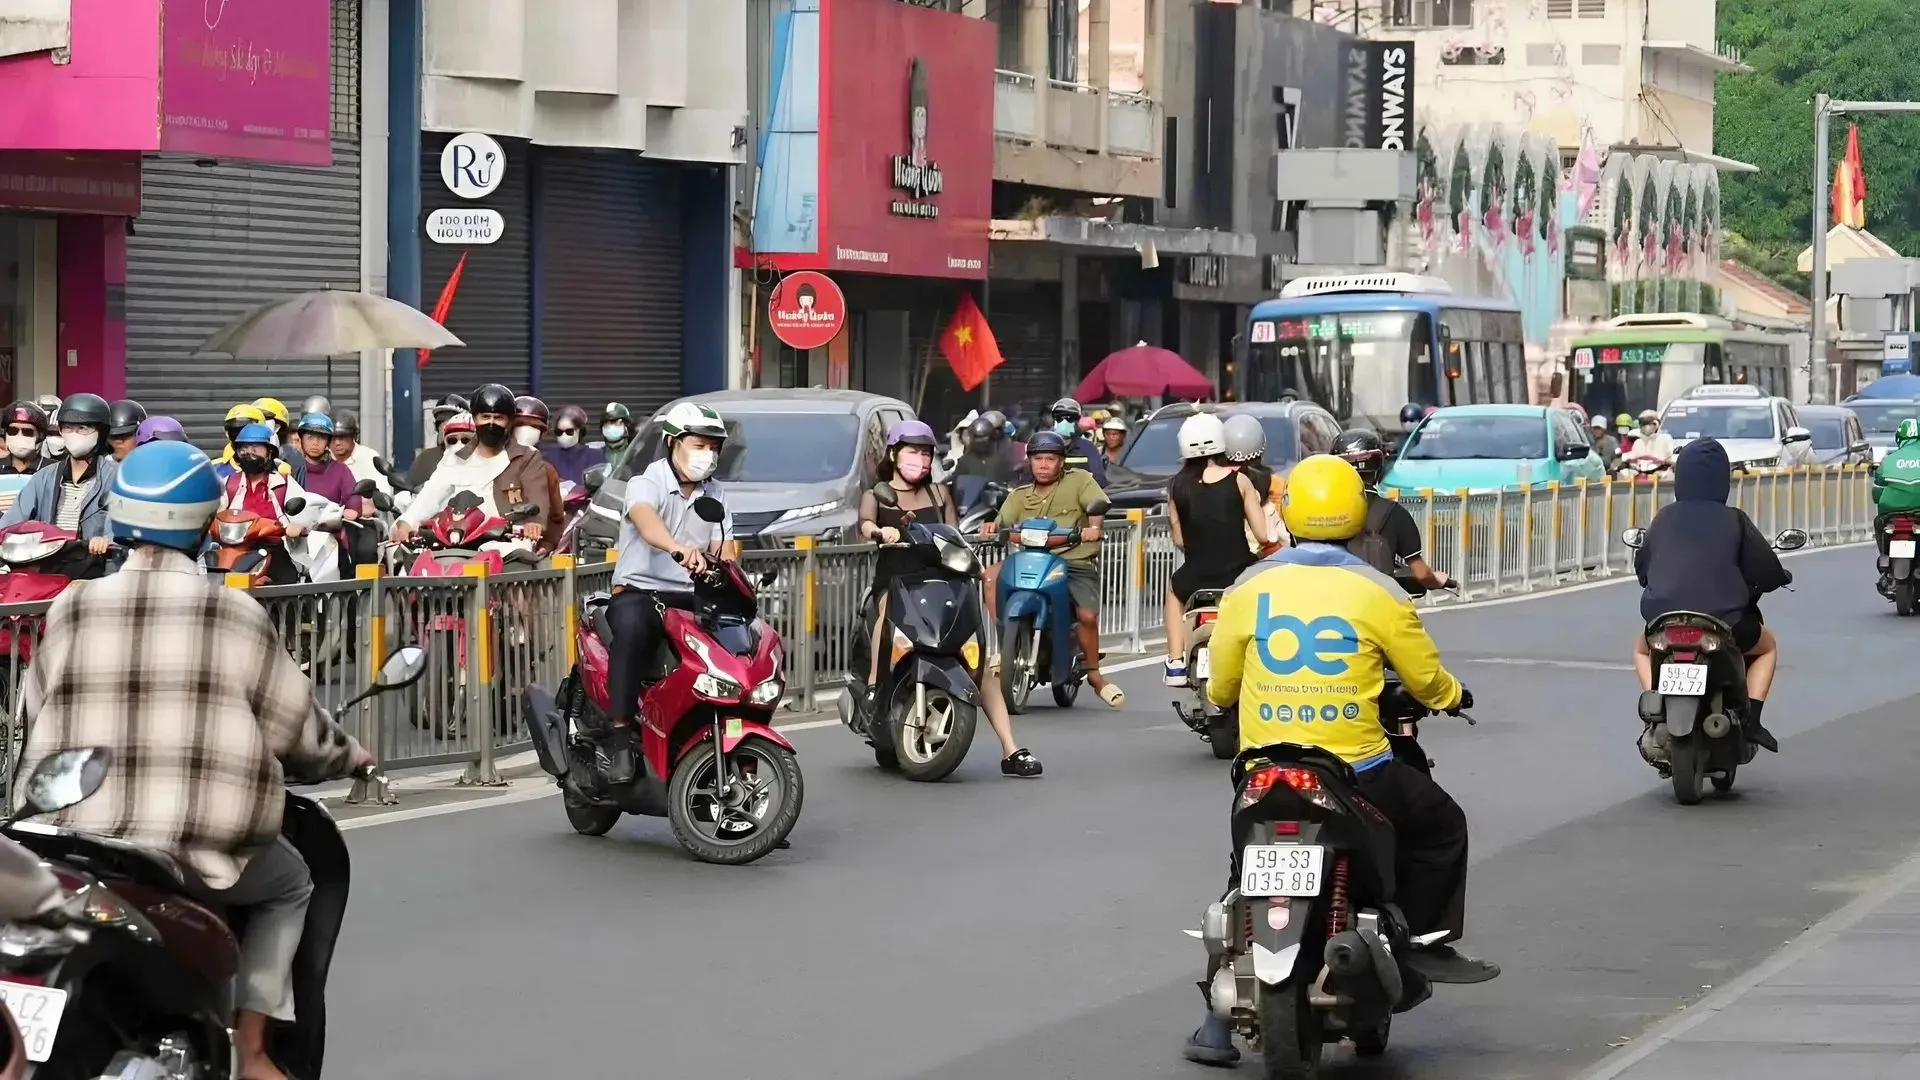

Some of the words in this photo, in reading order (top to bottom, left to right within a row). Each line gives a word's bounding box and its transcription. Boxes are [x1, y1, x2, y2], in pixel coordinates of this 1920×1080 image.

[1256, 323, 1271, 341] 31
[1255, 592, 1358, 676] be
[1247, 872, 1316, 892] 035.88
